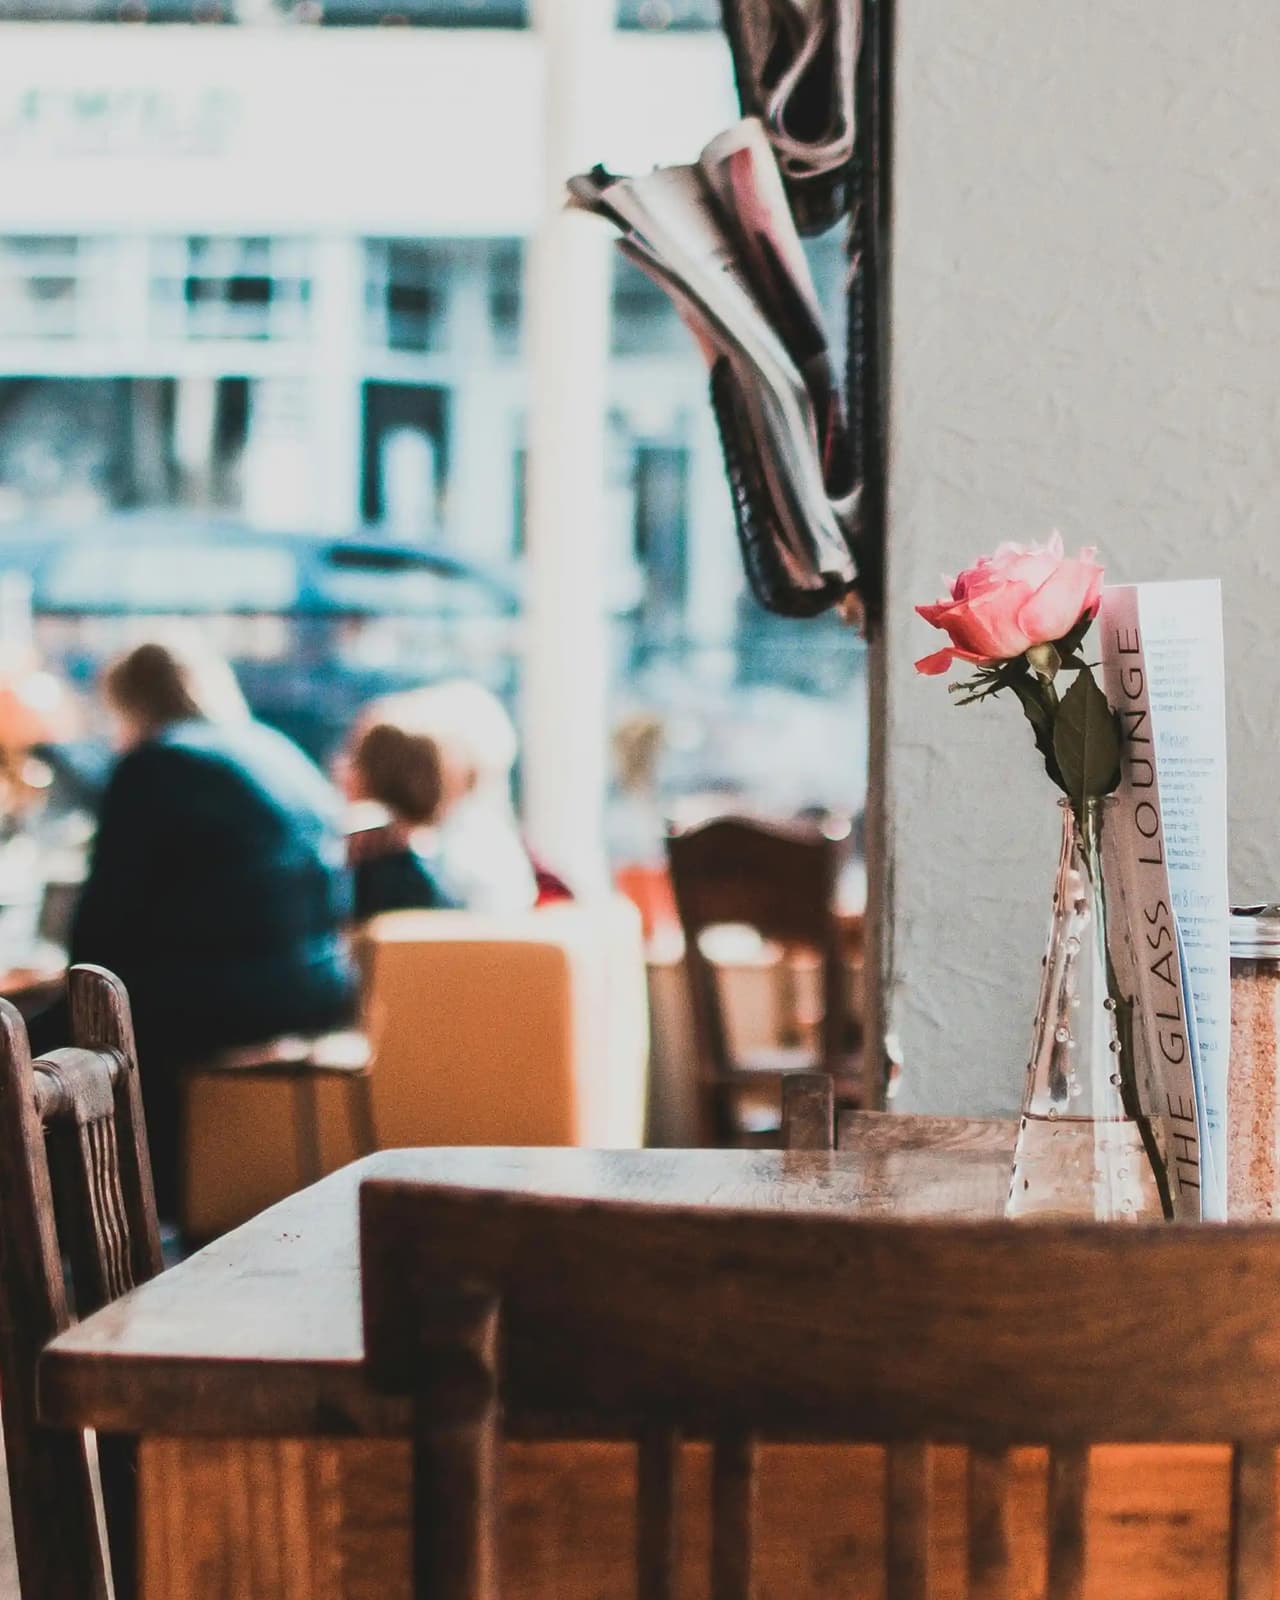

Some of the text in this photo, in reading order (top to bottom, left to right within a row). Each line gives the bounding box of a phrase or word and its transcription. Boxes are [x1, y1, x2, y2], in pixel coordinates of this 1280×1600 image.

[1117, 628, 1163, 864] LOUNGE
[1144, 900, 1186, 1064] GLASS
[1167, 1094, 1200, 1194] THE
